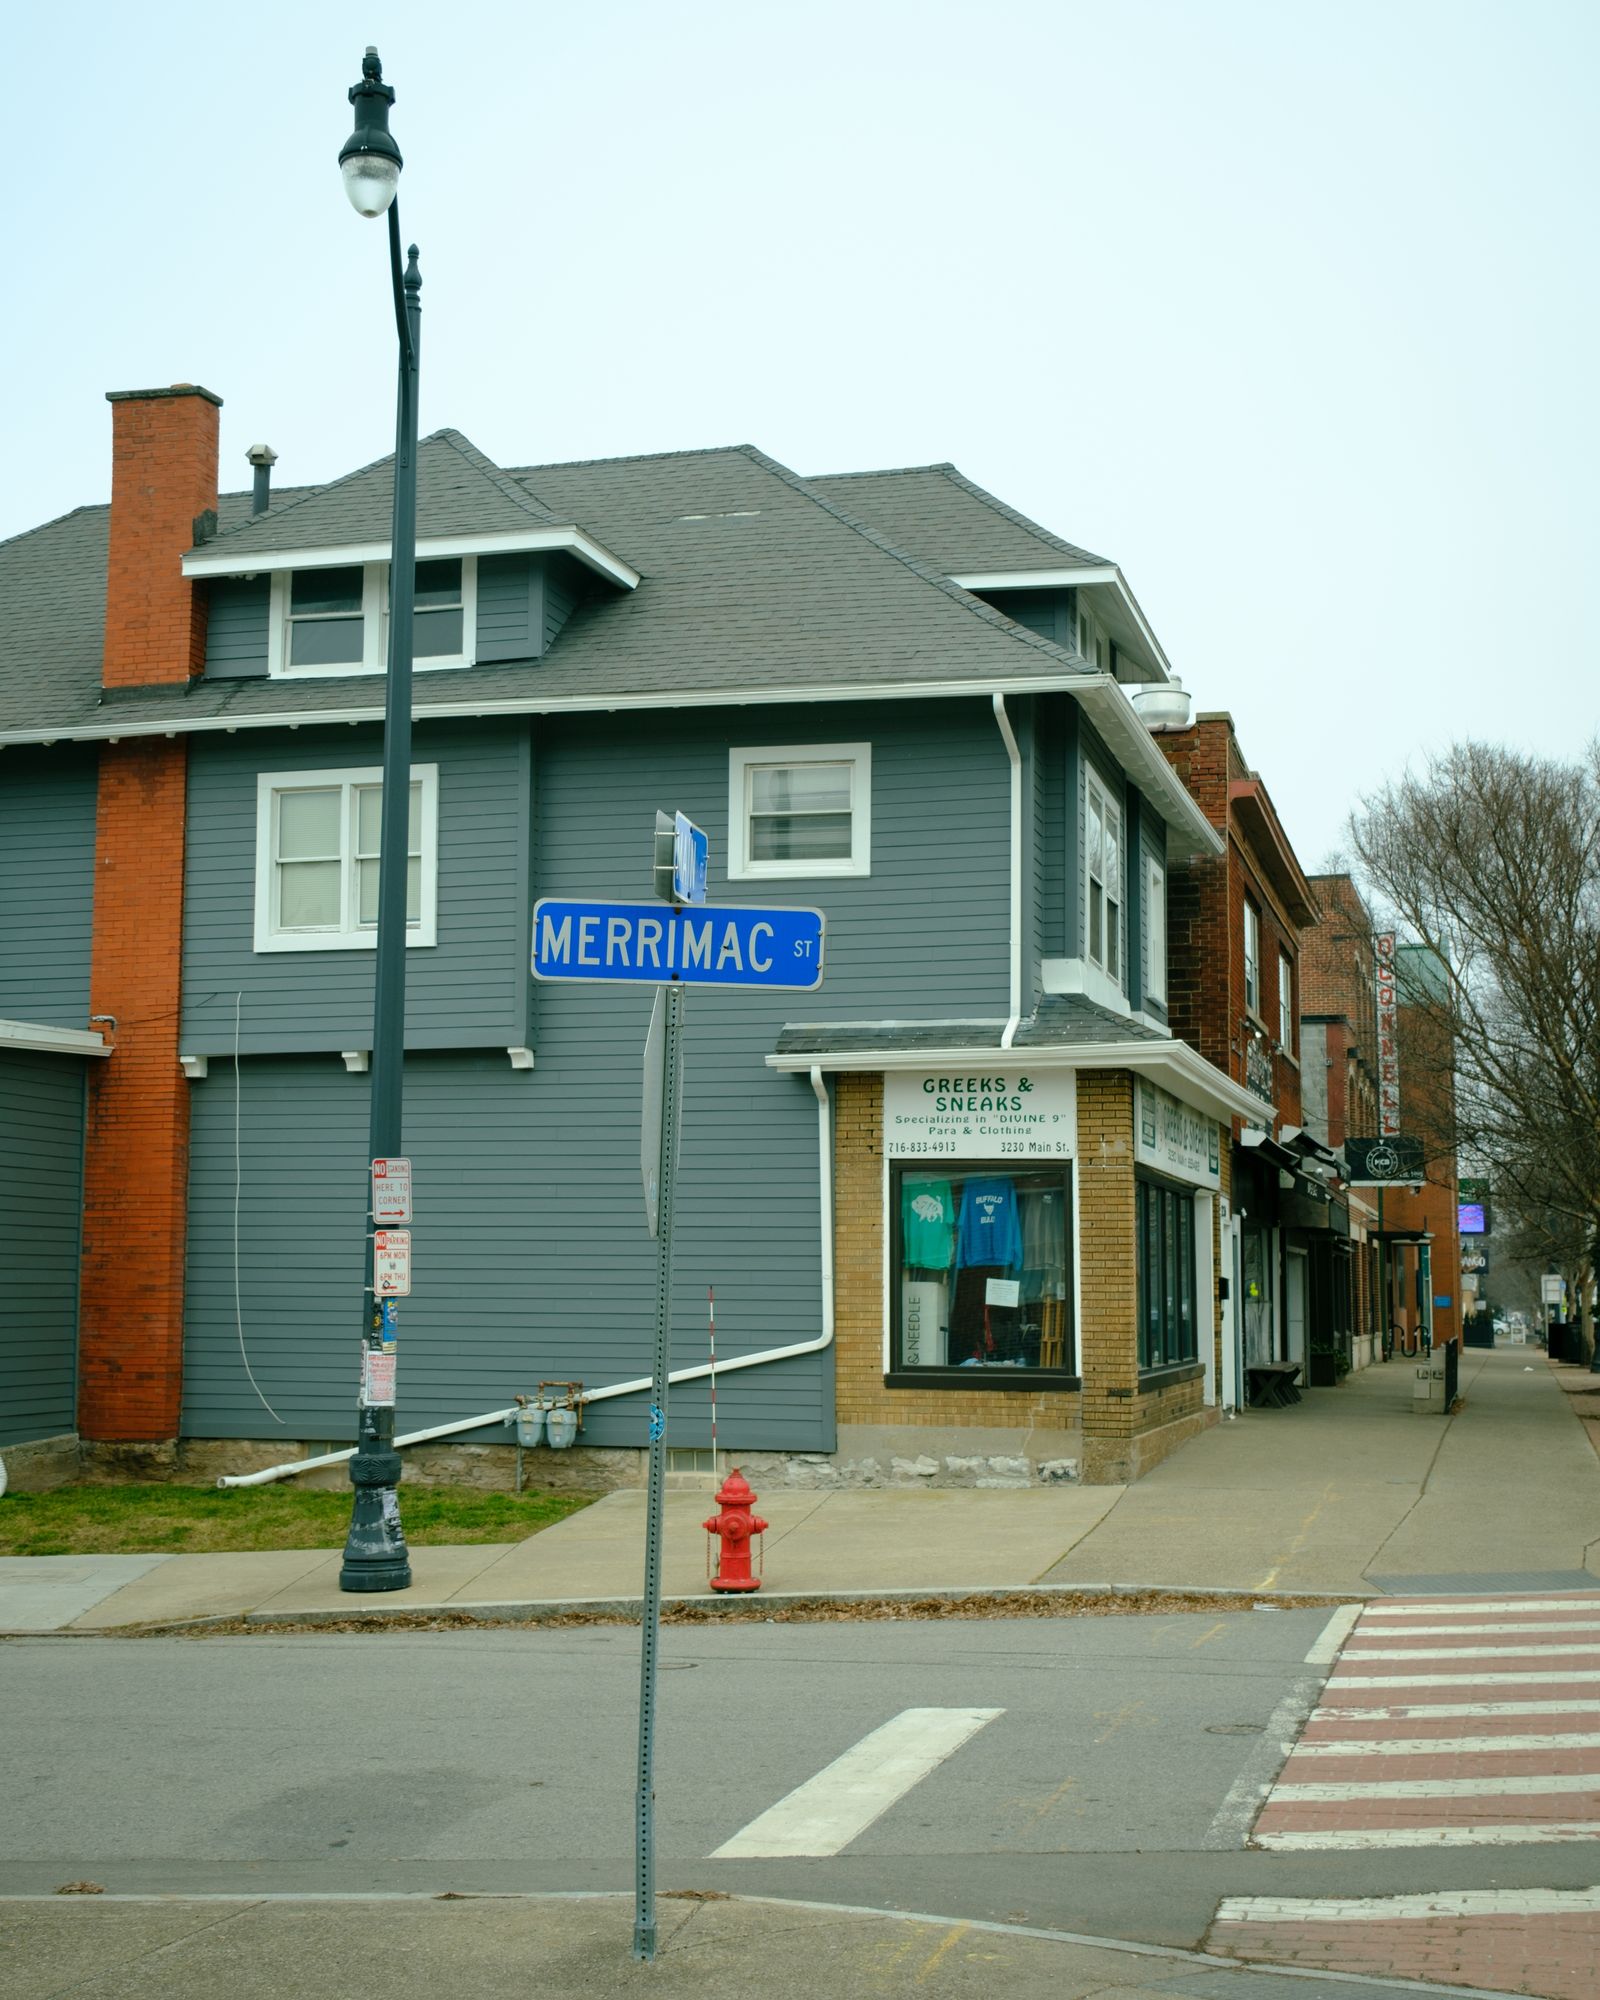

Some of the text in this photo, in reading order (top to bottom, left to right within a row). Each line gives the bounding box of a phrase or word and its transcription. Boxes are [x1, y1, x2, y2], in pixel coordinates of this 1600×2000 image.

[541, 915, 813, 972] MERRIMAC ST
[923, 1077, 1034, 1093] GREEKS &
[936, 1096, 1022, 1112] SNEAKS
[895, 1115, 970, 1124] Specializing
[975, 1115, 986, 1123] in
[993, 1114, 1046, 1123] "DIVINE
[929, 1126, 1032, 1136] Para & Clothing
[889, 1142, 1070, 1152] 716-833-4913 3230 Main St.
[375, 1163, 385, 1174] NO
[376, 1182, 408, 1192] HERE TO
[378, 1195, 407, 1205] CORNER
[376, 1235, 409, 1246] NO PARKING
[379, 1251, 406, 1260] 6PM MON
[379, 1272, 406, 1281] 6PM THU
[908, 1296, 920, 1350] NEEDLE
